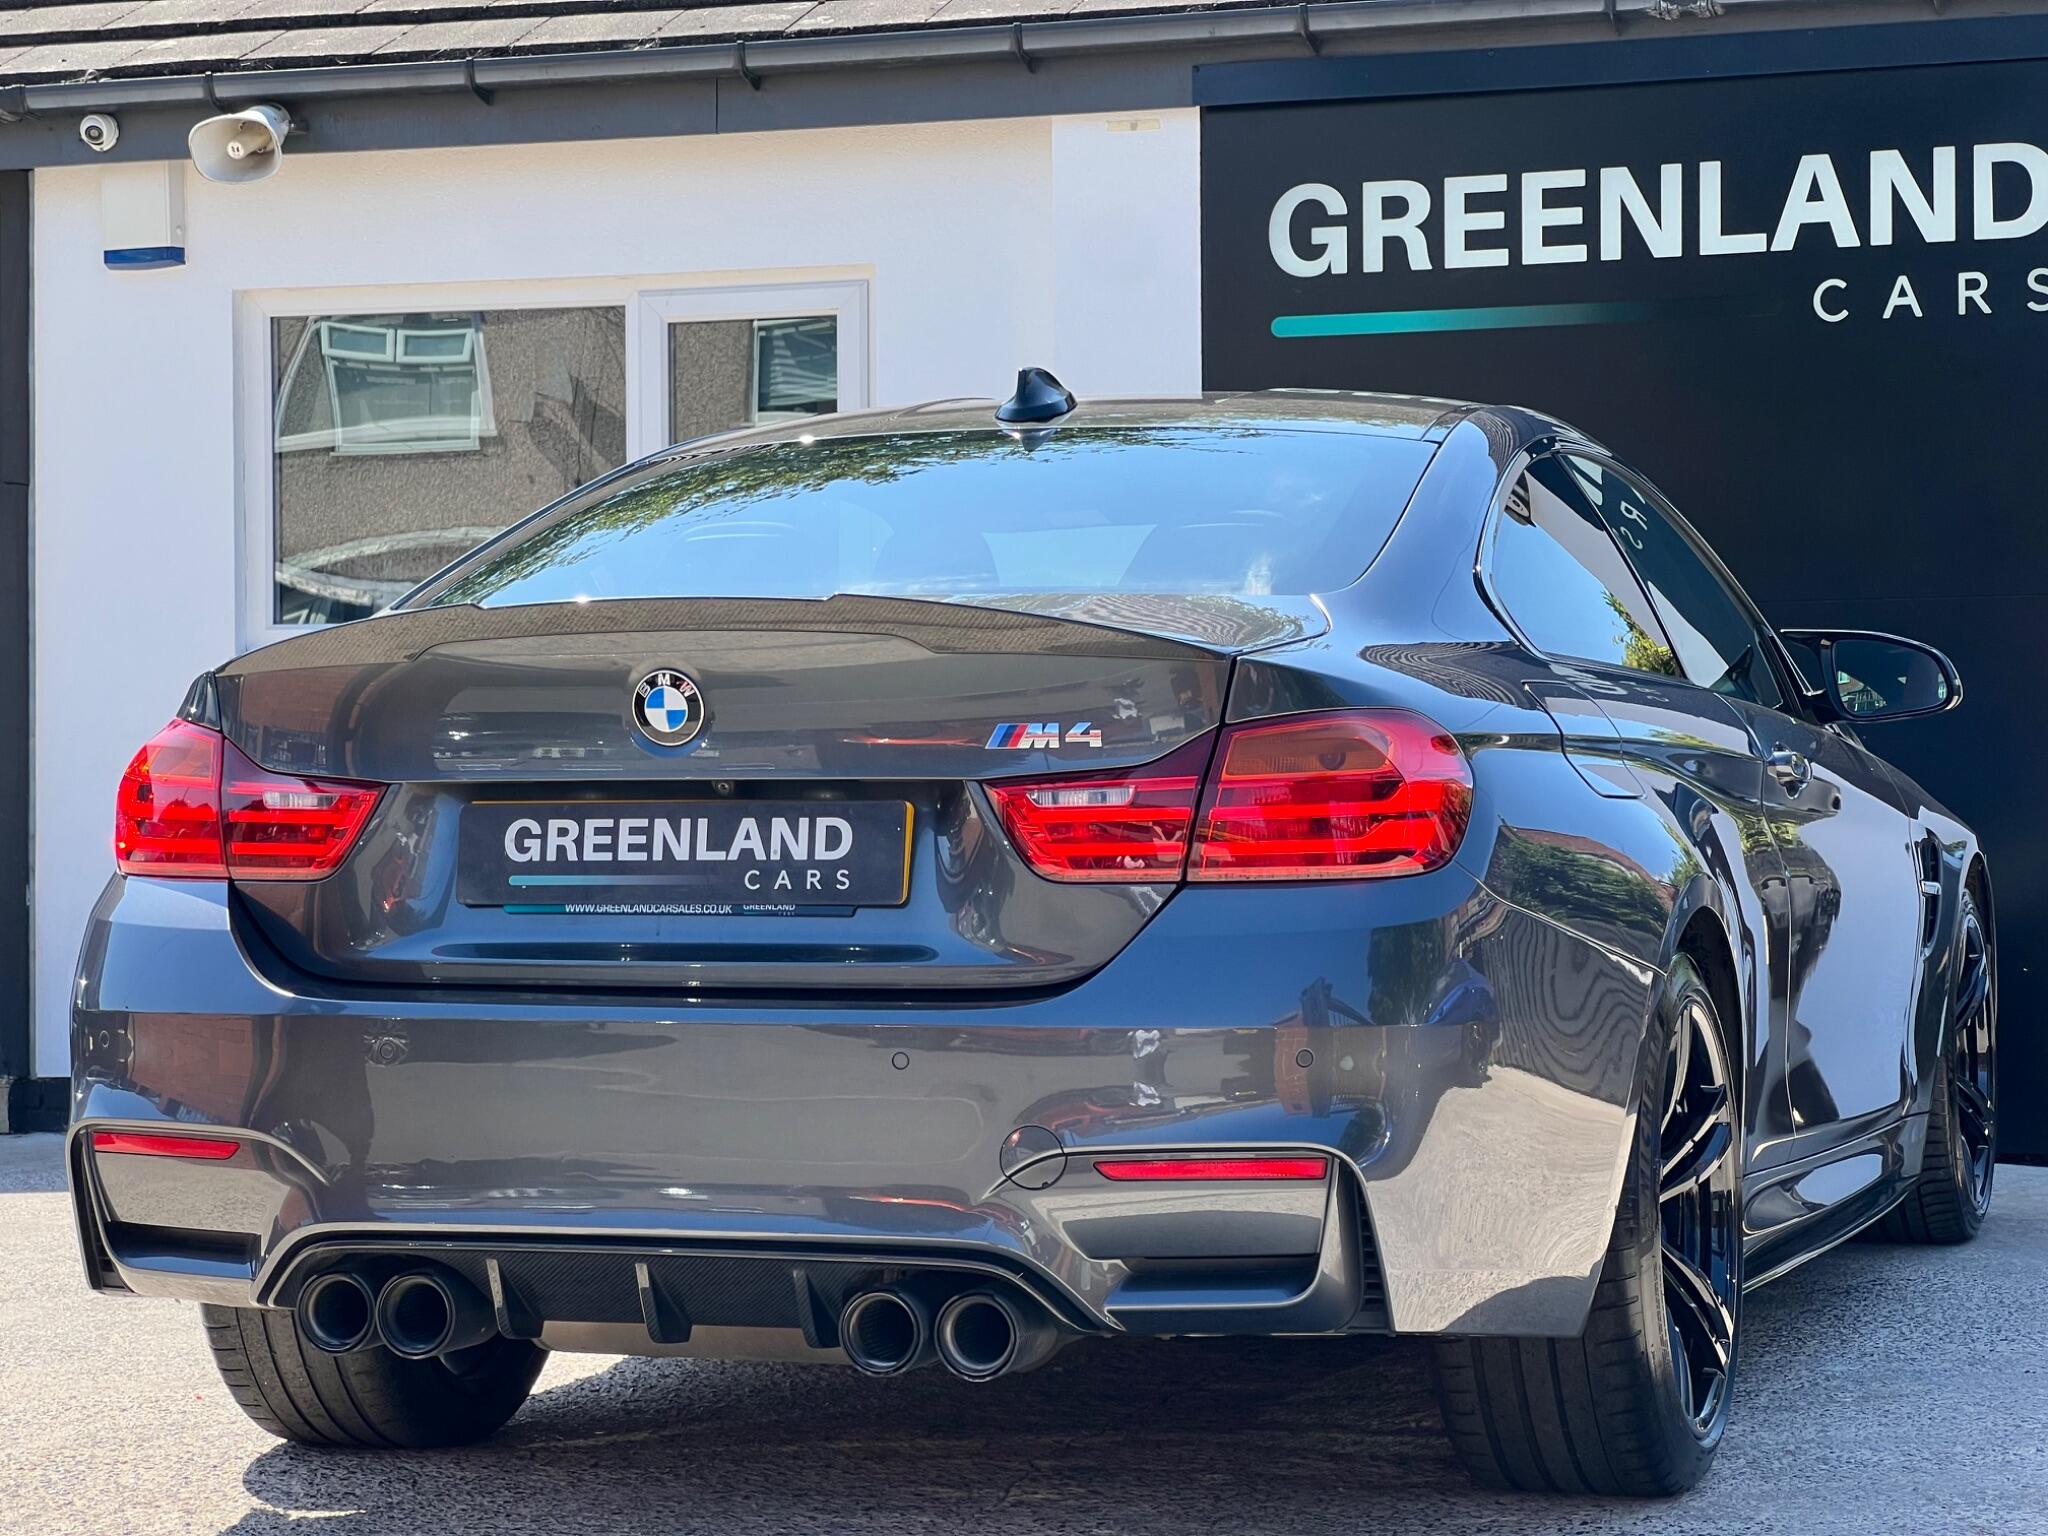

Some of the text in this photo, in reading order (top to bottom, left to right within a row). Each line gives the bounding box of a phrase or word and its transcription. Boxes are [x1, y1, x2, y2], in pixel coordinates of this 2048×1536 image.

[1267, 142, 2048, 279] GREENLAND
[1812, 266, 2048, 324] CARS
[636, 672, 696, 698] BMW
[985, 721, 1103, 750] M4
[504, 817, 853, 862] GREENLAND
[744, 869, 851, 891] CARS
